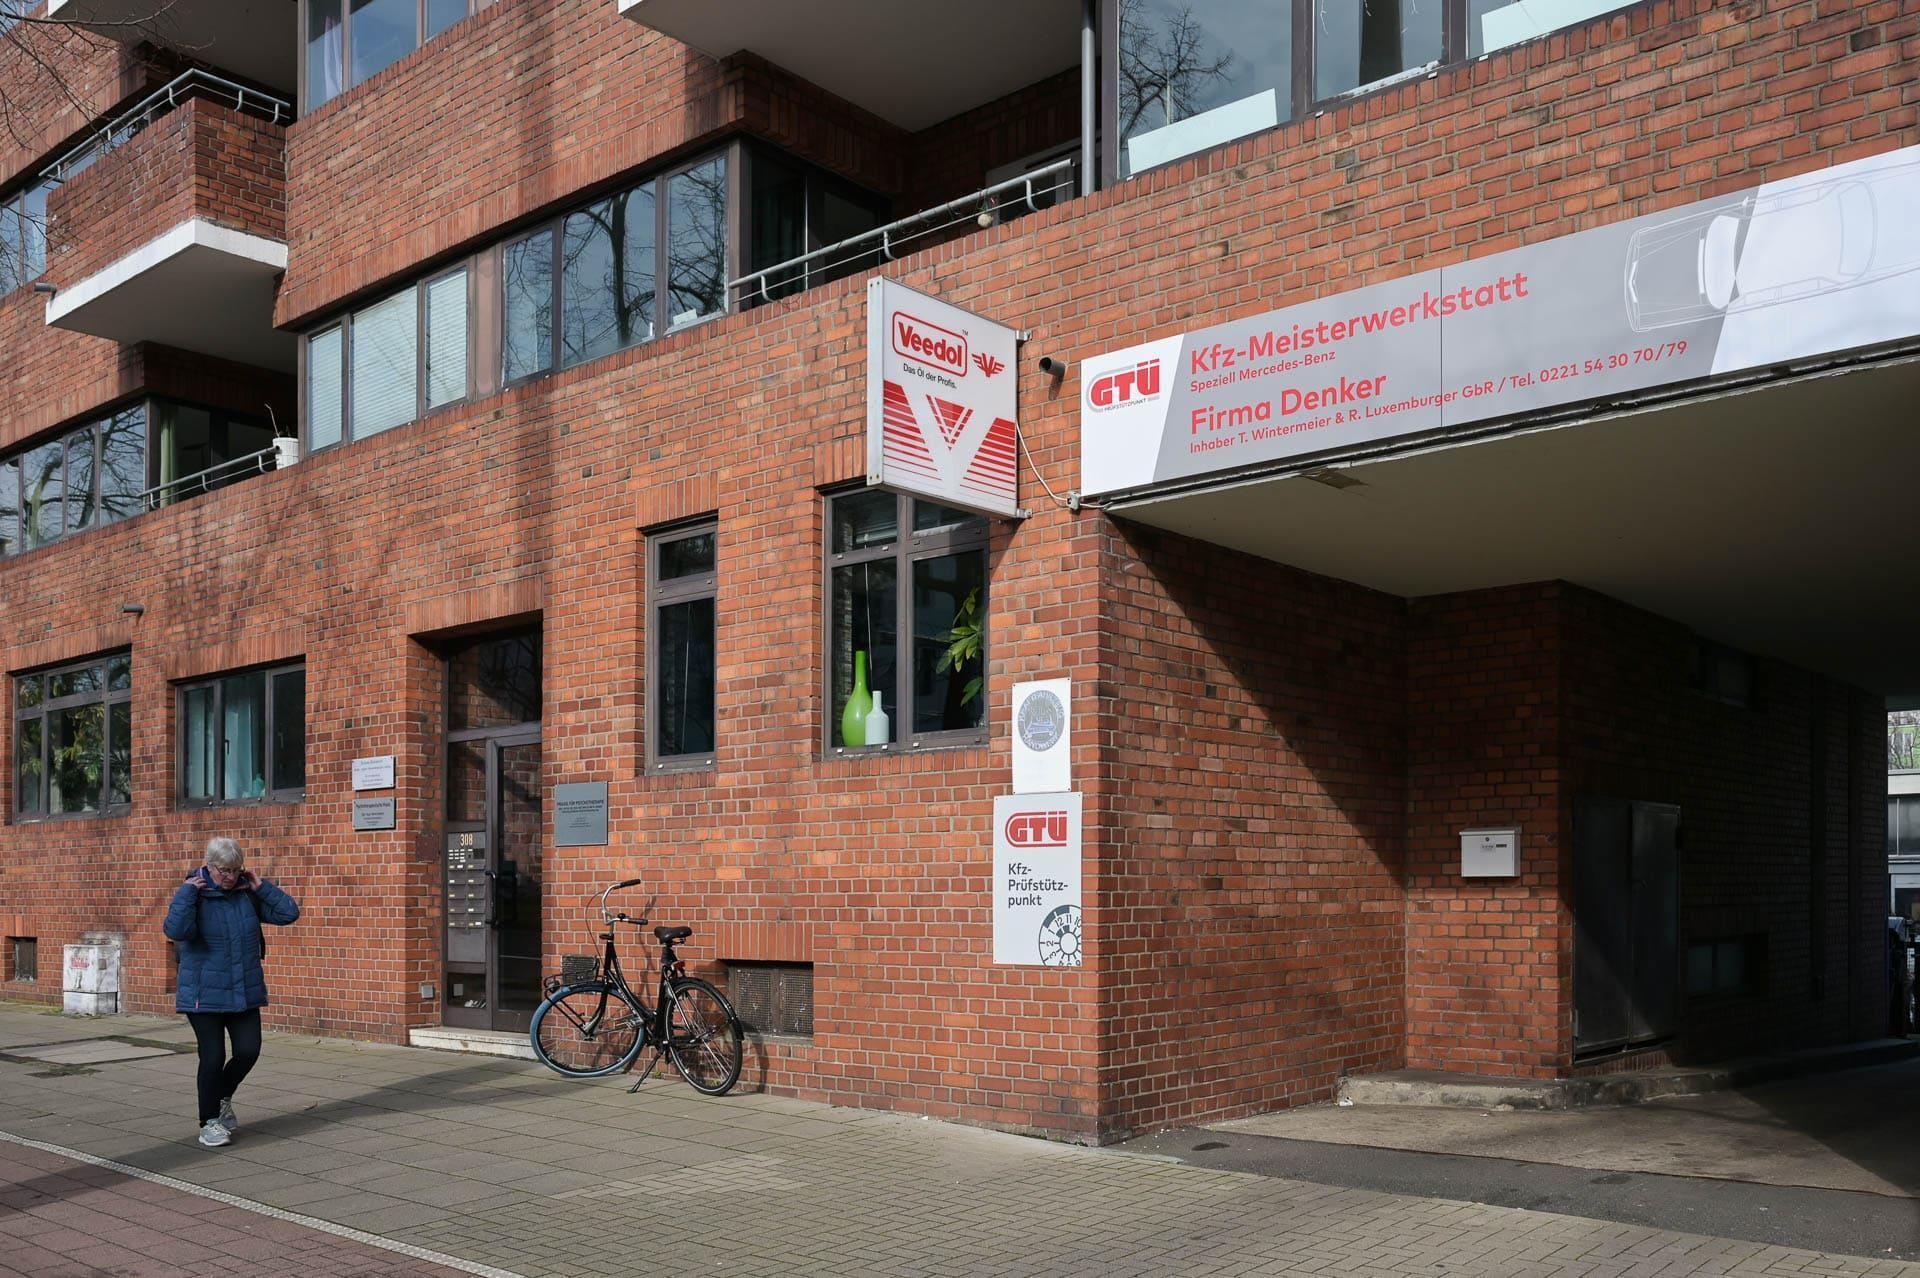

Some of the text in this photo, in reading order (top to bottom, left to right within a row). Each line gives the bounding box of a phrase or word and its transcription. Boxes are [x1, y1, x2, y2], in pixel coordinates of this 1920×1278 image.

[1191, 273, 1529, 374] Kfz-Meisterwerkstatt
[898, 321, 963, 367] Veedol
[903, 362, 916, 375] Das
[917, 366, 925, 378] Öl
[925, 372, 937, 382] der
[1090, 358, 1160, 407] GTÜ
[1190, 351, 1337, 393] Speziell Mercedes-Benz
[1190, 340, 1688, 454] Inhaber T. Wintermeier & R. Luxemburger GbR / Tel. 0221 54 30 70/79
[1191, 375, 1387, 435] Firma Denker
[460, 833, 474, 846] 308
[1007, 811, 1068, 843] GTÜ
[1008, 862, 1032, 875] Kfz-
[1008, 878, 1069, 891] Prüfstütz-
[1008, 893, 1042, 909] punkt
[1054, 916, 1065, 928] 12
[1049, 951, 1057, 959] 3
